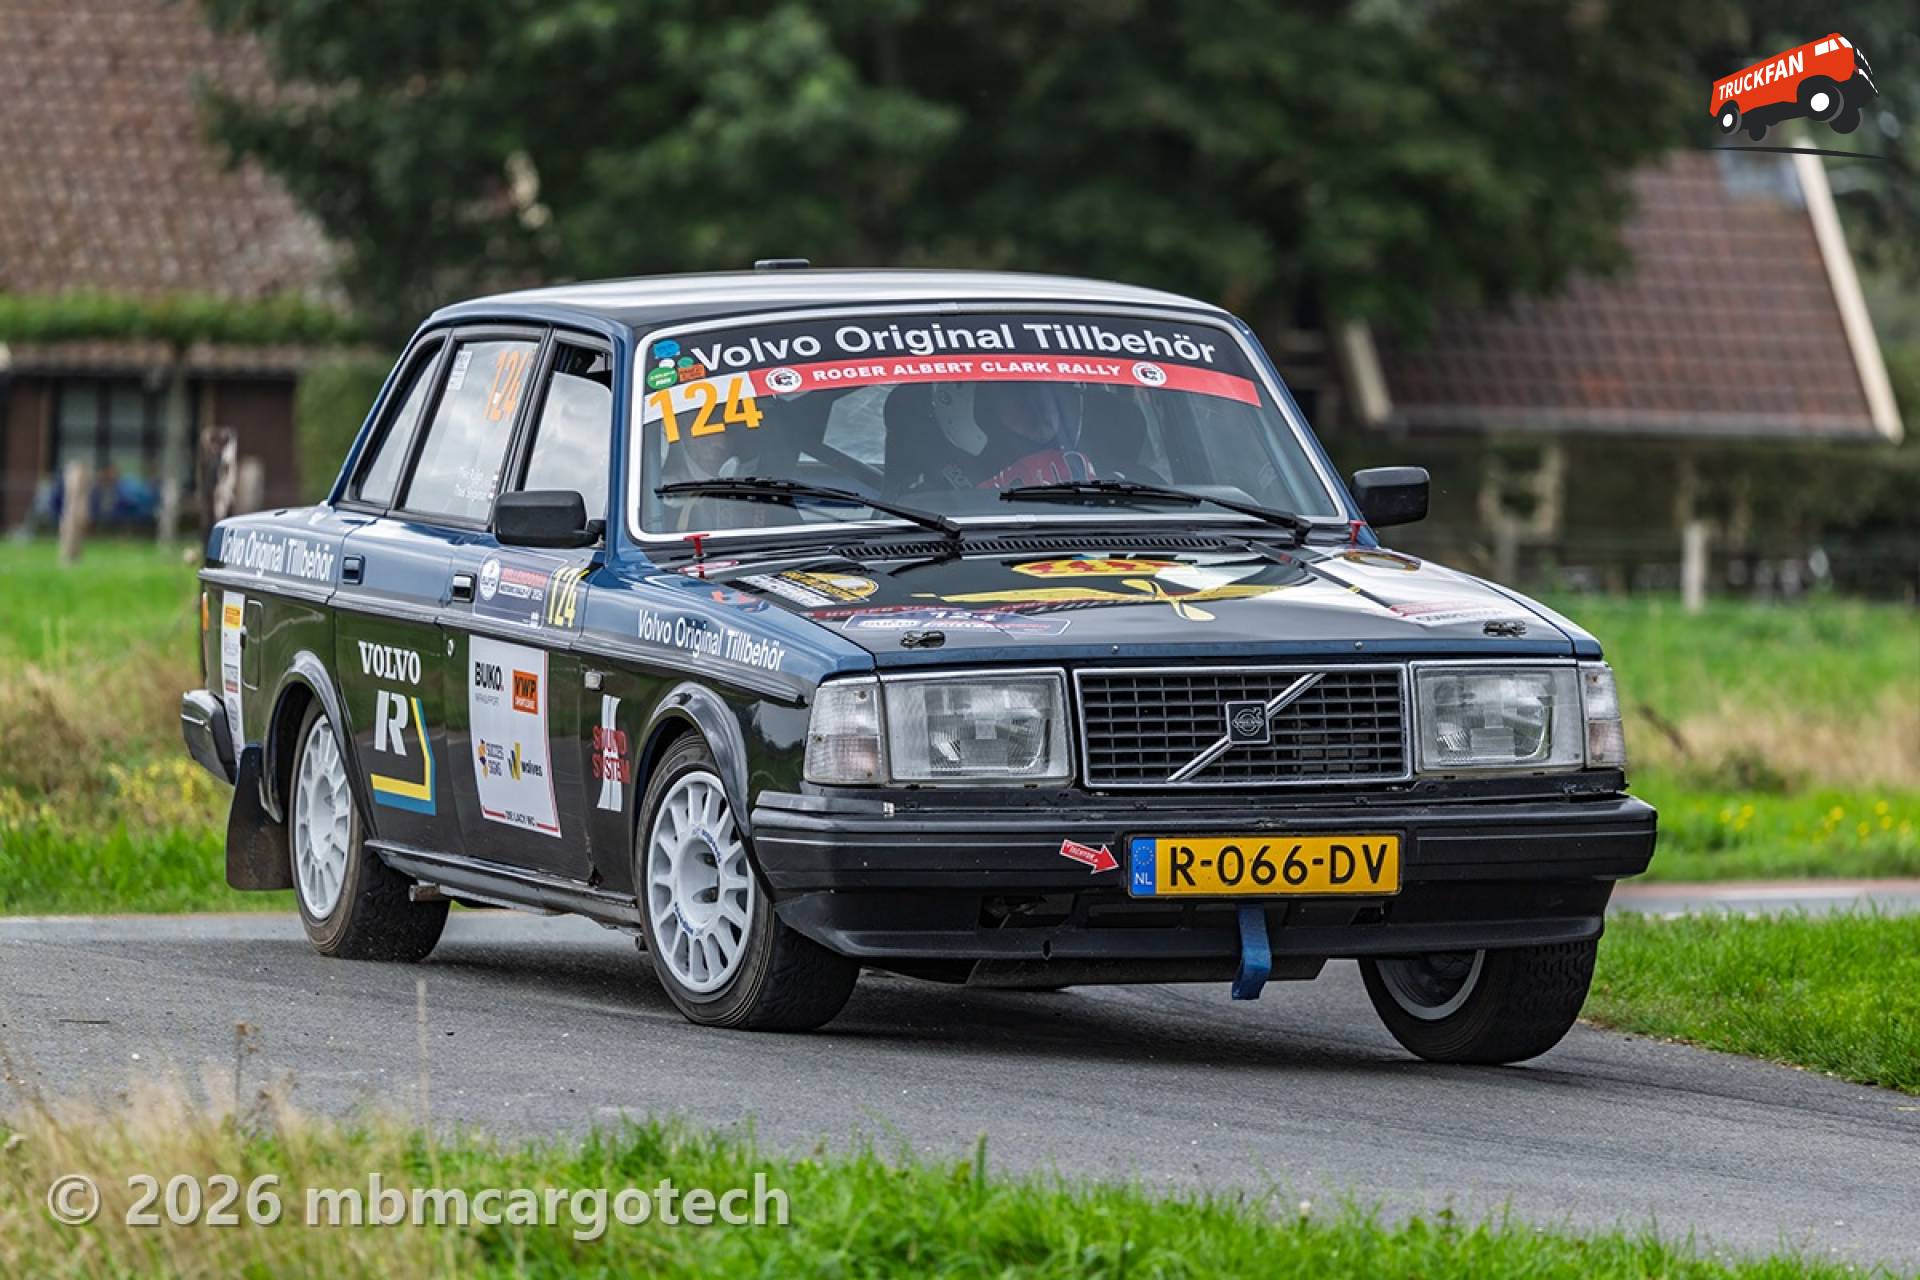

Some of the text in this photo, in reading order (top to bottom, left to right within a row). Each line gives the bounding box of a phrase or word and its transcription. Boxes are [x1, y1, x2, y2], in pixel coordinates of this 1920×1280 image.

[690, 335, 821, 371] Volvo
[835, 323, 1015, 356] Original
[1023, 323, 1217, 363] Tillbehör
[812, 365, 887, 382] ROGER
[893, 362, 973, 377] ALBERT
[980, 361, 1052, 374] CLARK
[1057, 361, 1122, 377] RALLY
[483, 351, 529, 421] 124
[650, 376, 764, 443] 124
[219, 528, 334, 582] Volvo Original Tillbehör
[548, 566, 590, 628] 124
[358, 640, 421, 685] VOLVO
[638, 609, 785, 672] Volvo Original Tillbehör
[374, 690, 409, 756] R
[1135, 872, 1153, 886] NL
[1169, 844, 1388, 887] R-066-DV
